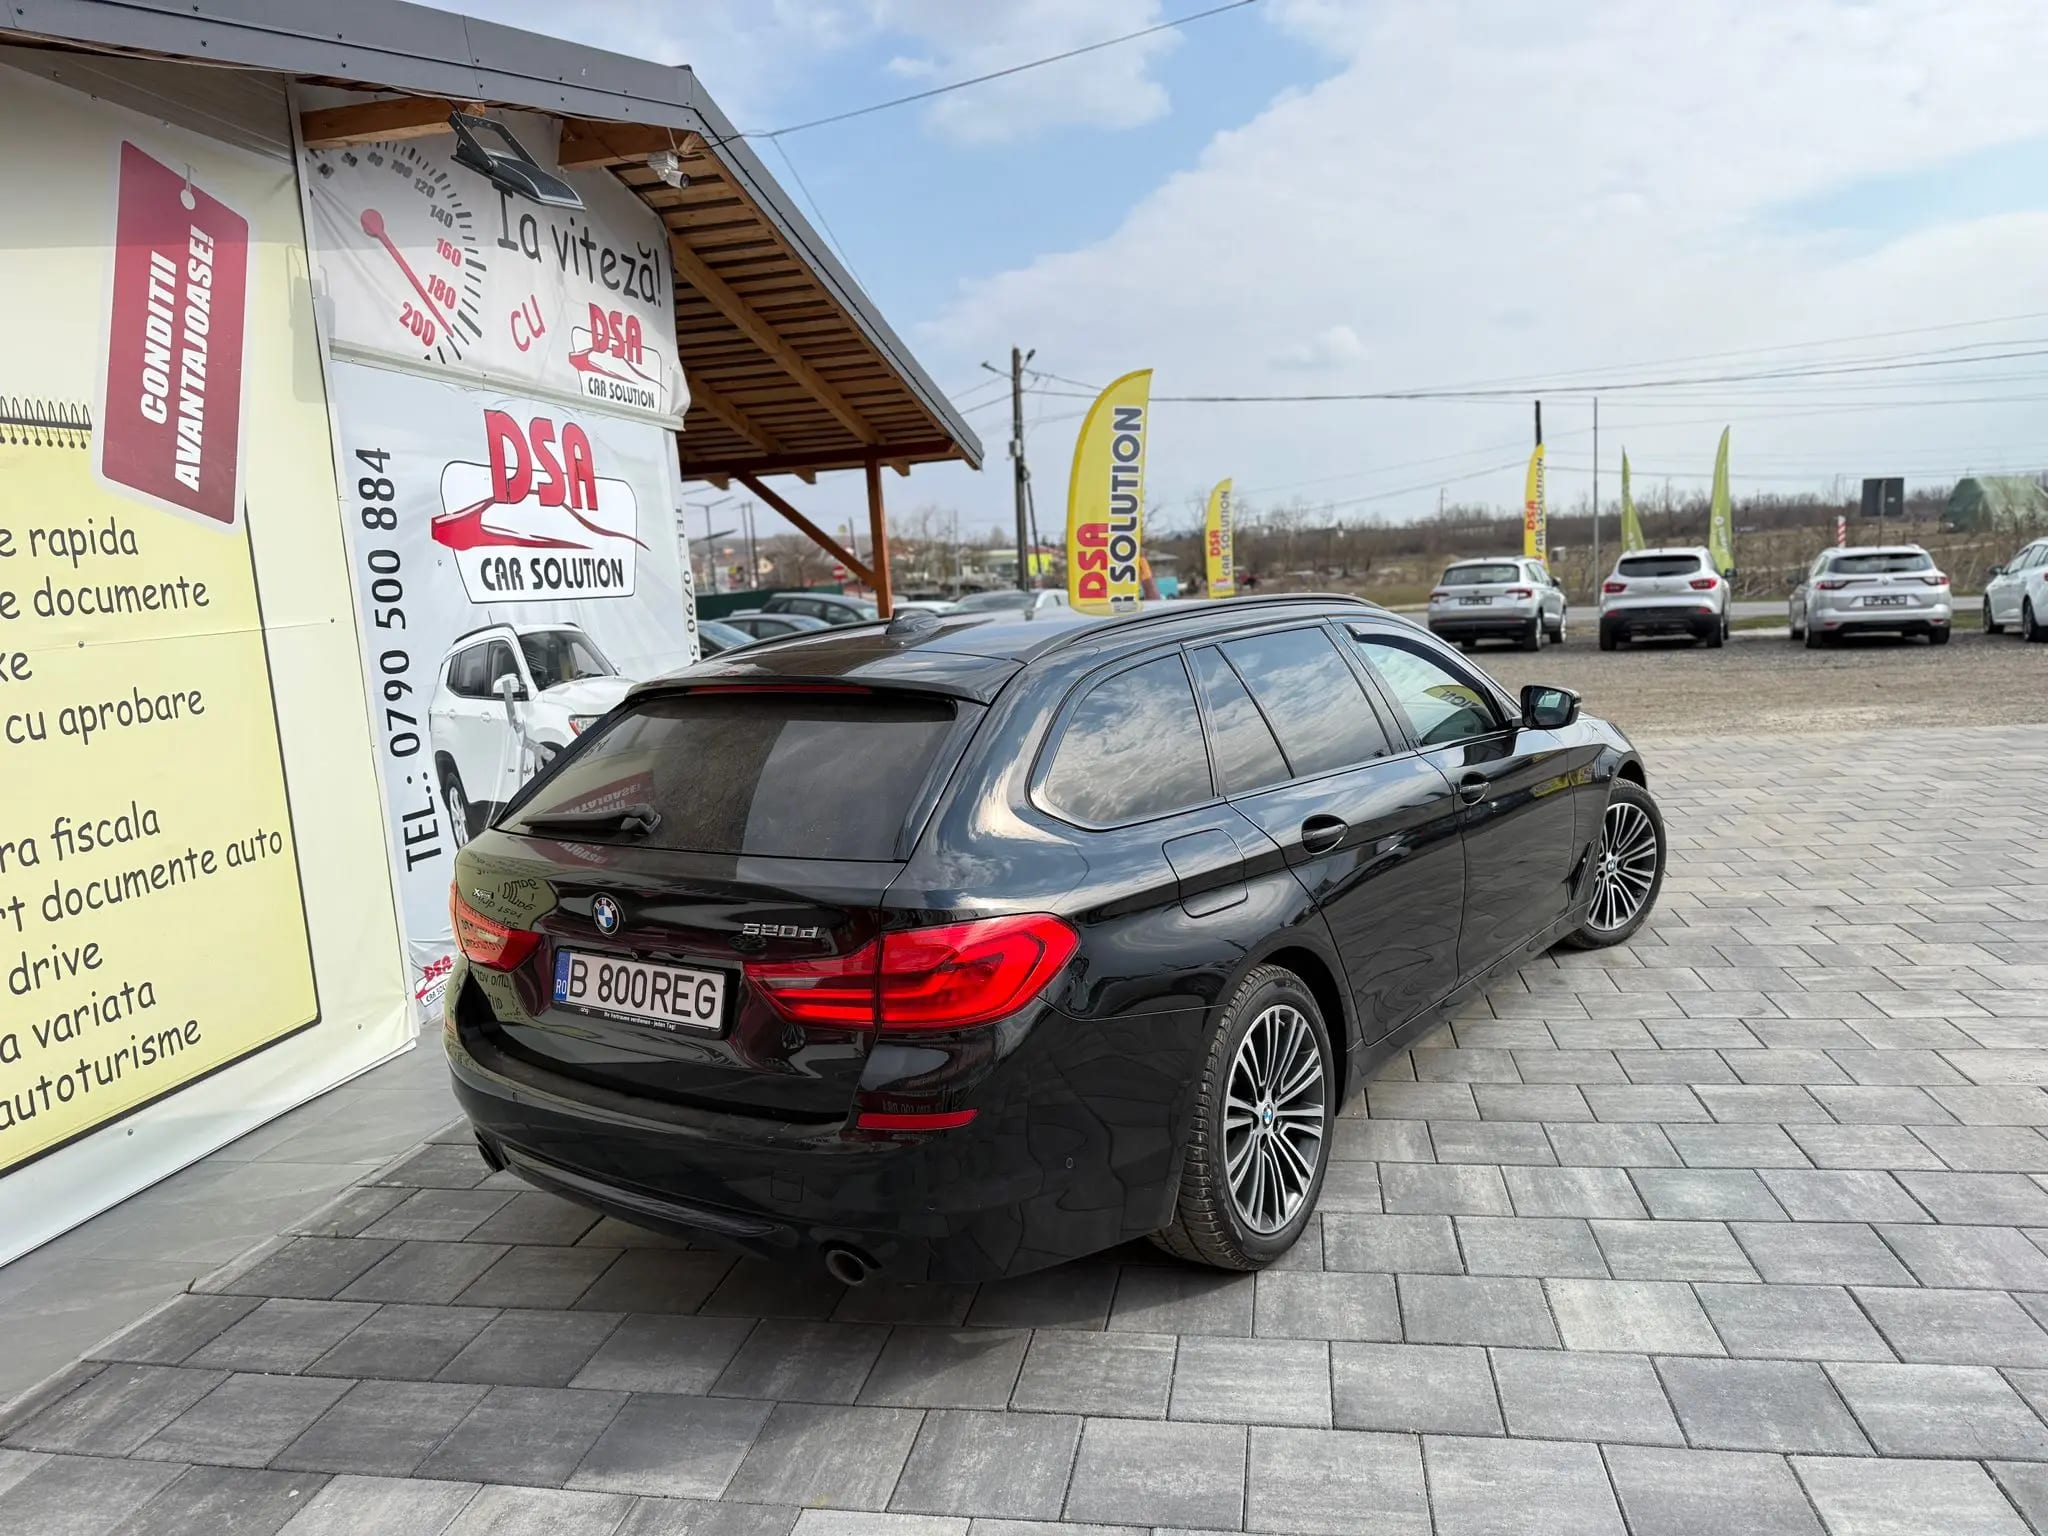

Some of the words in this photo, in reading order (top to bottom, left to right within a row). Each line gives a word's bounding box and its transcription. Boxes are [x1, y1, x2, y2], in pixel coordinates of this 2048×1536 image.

[414, 178, 436, 198] 120
[430, 204, 453, 228] 140
[437, 238, 461, 267] 160
[552, 217, 662, 307] viteză!
[427, 274, 456, 309] 180
[141, 250, 177, 424] CONDITII
[399, 301, 436, 346] 200
[510, 294, 546, 351] cu
[589, 302, 642, 365] DSA
[174, 224, 214, 492] AVANTAJOASE!
[588, 377, 607, 397] CAR
[609, 382, 655, 408] SOLUTION
[484, 409, 598, 511] DSA
[355, 448, 398, 531] 884
[1110, 407, 1143, 583] SOLUTION
[1527, 500, 1536, 530] DSA
[29, 515, 139, 569] rapida
[1209, 530, 1221, 557] DSA
[1220, 491, 1231, 550] SOLUTION
[368, 549, 406, 630] 500
[480, 556, 525, 591] CAR
[530, 557, 625, 590] SOLUTION
[1076, 523, 1109, 598] DSA
[1222, 555, 1231, 576] CAR
[33, 575, 210, 618] documente
[683, 570, 696, 634] 0790
[5, 713, 47, 744] cu
[58, 686, 206, 745] aprobare
[379, 650, 421, 758] 0790
[50, 800, 161, 861] fiscala
[402, 771, 442, 873] TEL.:
[41, 847, 218, 923] documente
[226, 827, 282, 868] auto
[742, 922, 819, 939] 520d
[9, 942, 103, 995] drive
[423, 954, 453, 982] DSA
[555, 979, 567, 995] RO
[569, 959, 588, 998] B
[31, 980, 157, 1049] variata
[0, 1018, 202, 1131] autoturisme
